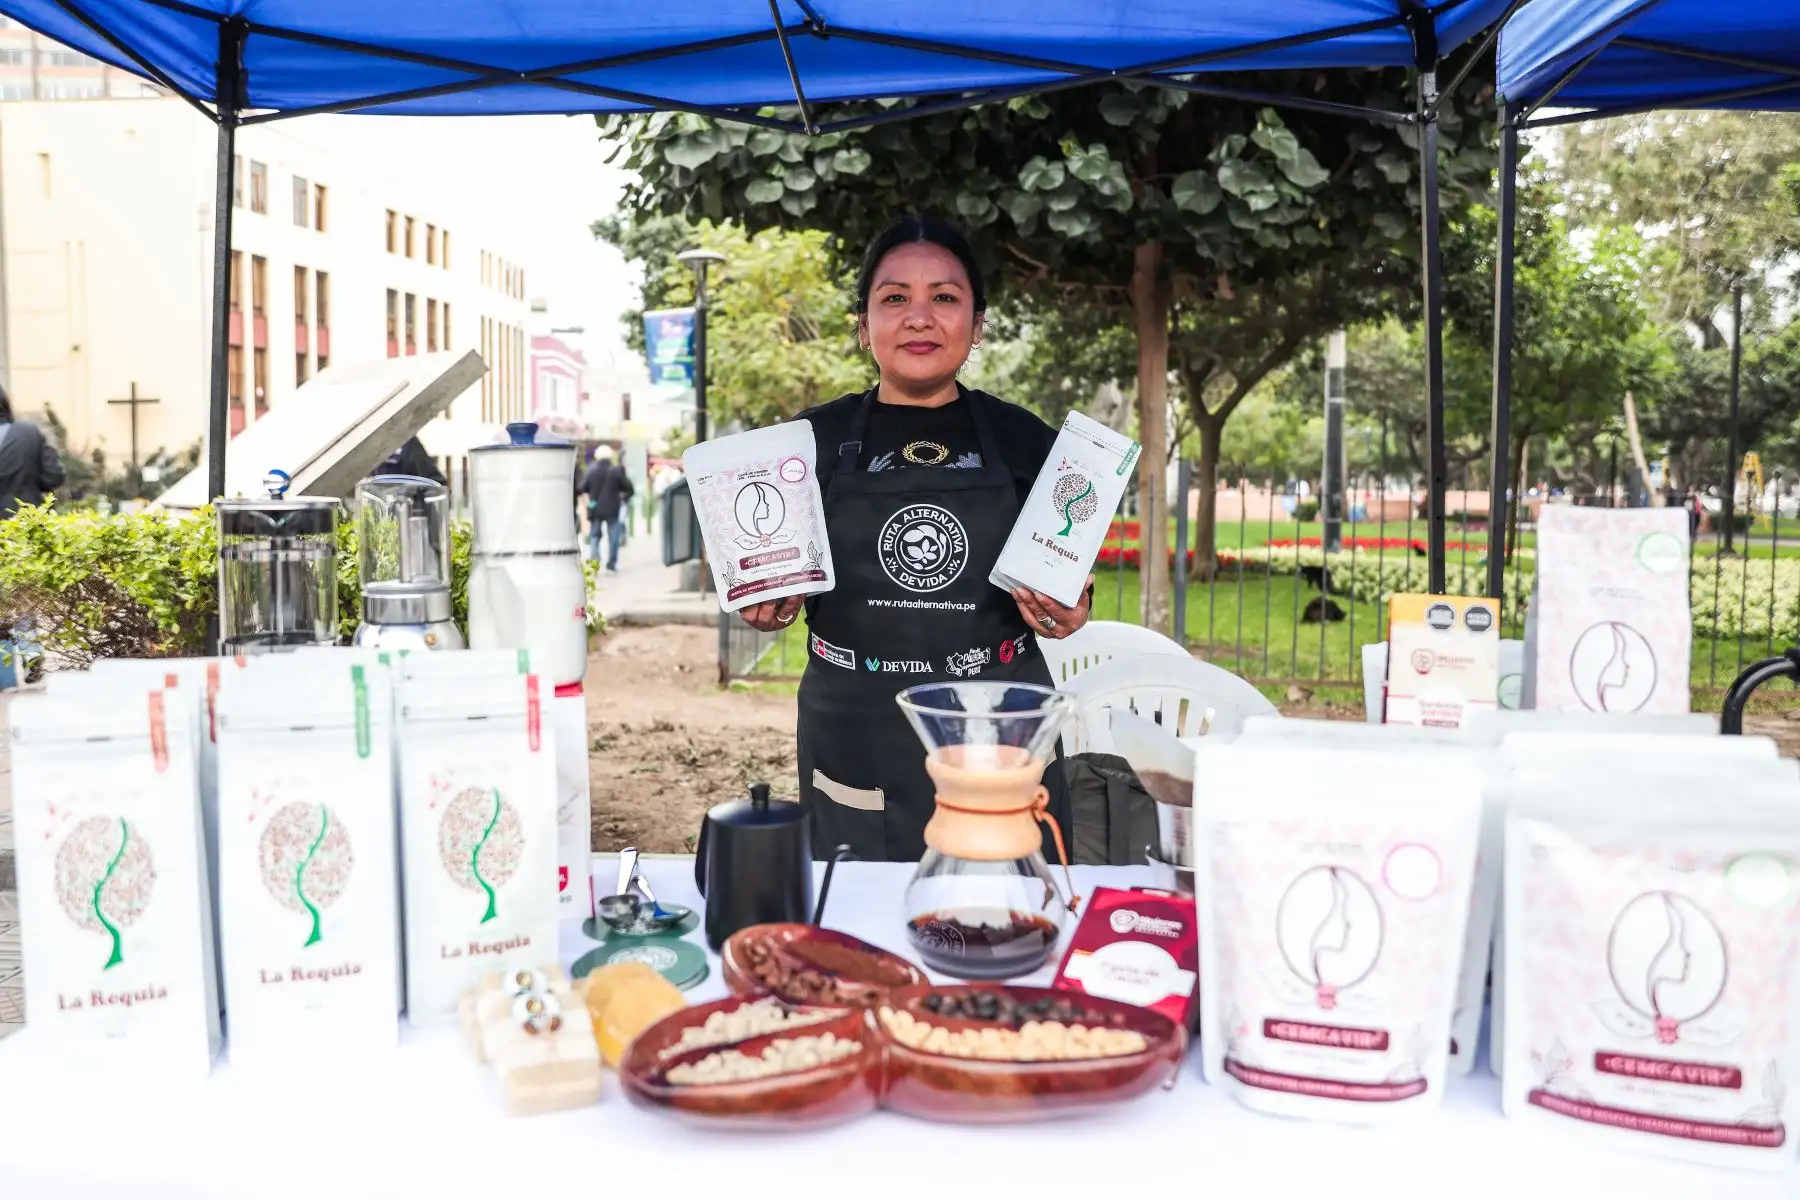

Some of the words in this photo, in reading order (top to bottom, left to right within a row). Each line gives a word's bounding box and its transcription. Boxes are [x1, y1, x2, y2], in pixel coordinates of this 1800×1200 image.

[883, 522, 902, 551] RUTA
[903, 508, 964, 554] ALTERNATIVA
[1031, 531, 1044, 544] La
[1045, 538, 1079, 563] Requia
[899, 572, 948, 587] DEVIDA
[868, 599, 976, 612] www.rutaalternativa.pe
[881, 660, 934, 673] DEVIDA
[441, 944, 462, 959] La
[259, 968, 284, 984] La
[57, 993, 83, 1011] La
